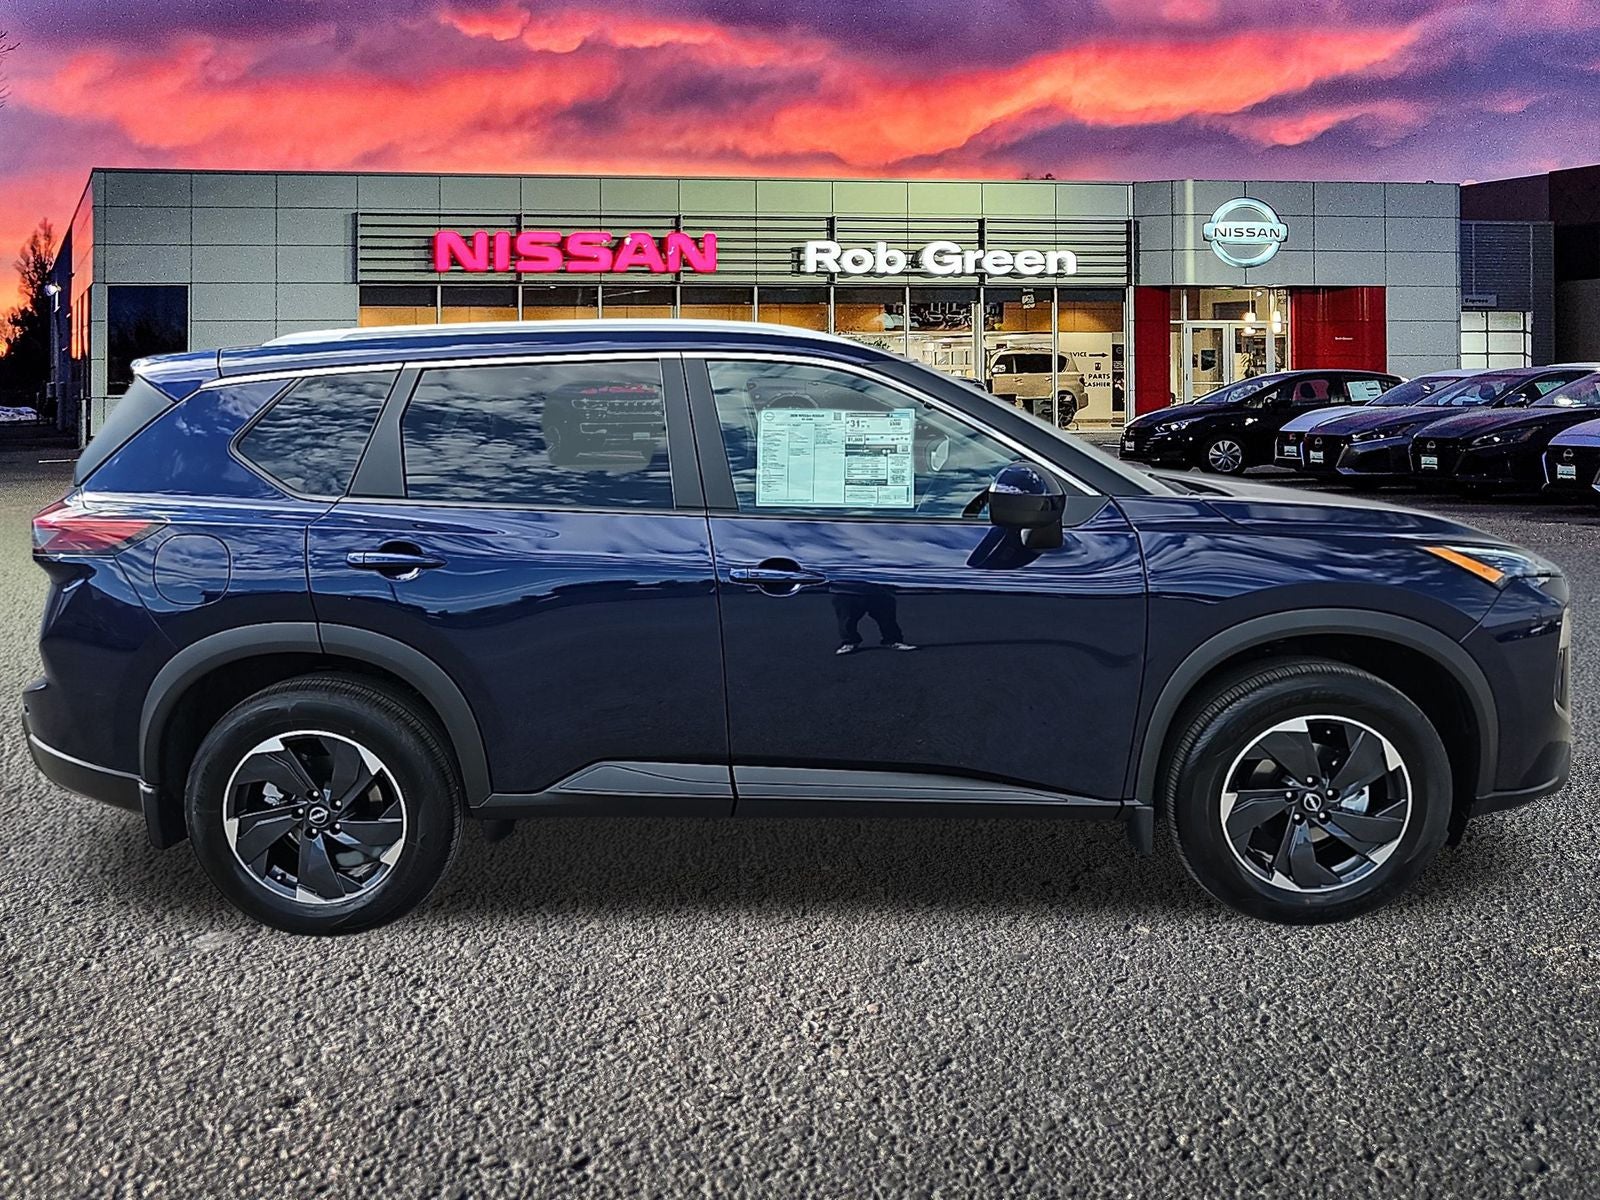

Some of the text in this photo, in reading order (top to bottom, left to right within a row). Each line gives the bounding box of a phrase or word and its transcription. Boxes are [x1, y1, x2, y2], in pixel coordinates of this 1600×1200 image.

[1214, 227, 1280, 238] NISSAN
[434, 231, 717, 273] NISSAN
[805, 240, 1078, 276] Rob Green
[850, 419, 860, 428] 31
